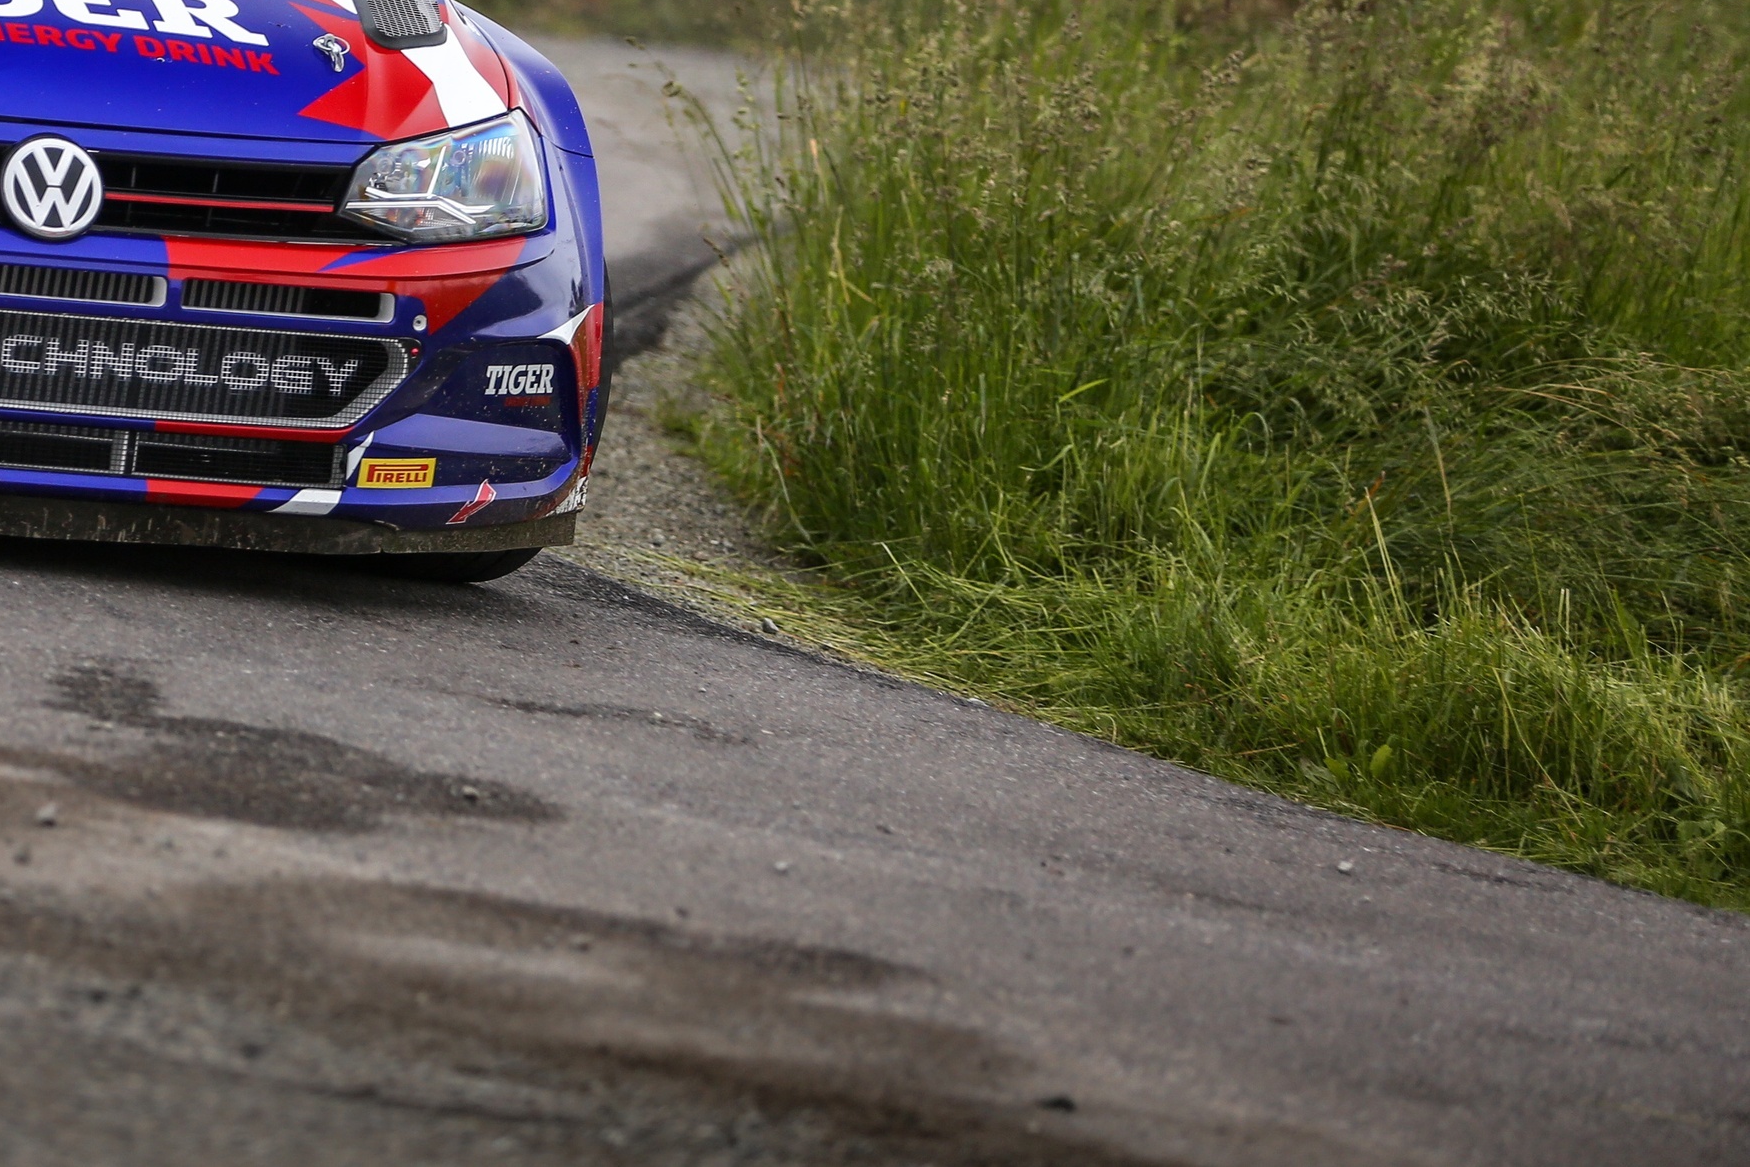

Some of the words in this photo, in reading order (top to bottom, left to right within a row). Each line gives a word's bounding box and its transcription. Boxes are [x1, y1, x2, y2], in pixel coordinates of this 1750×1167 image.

[136, 36, 280, 76] DRINK
[484, 363, 555, 395] TIGER
[366, 462, 428, 487] PIRELLI
